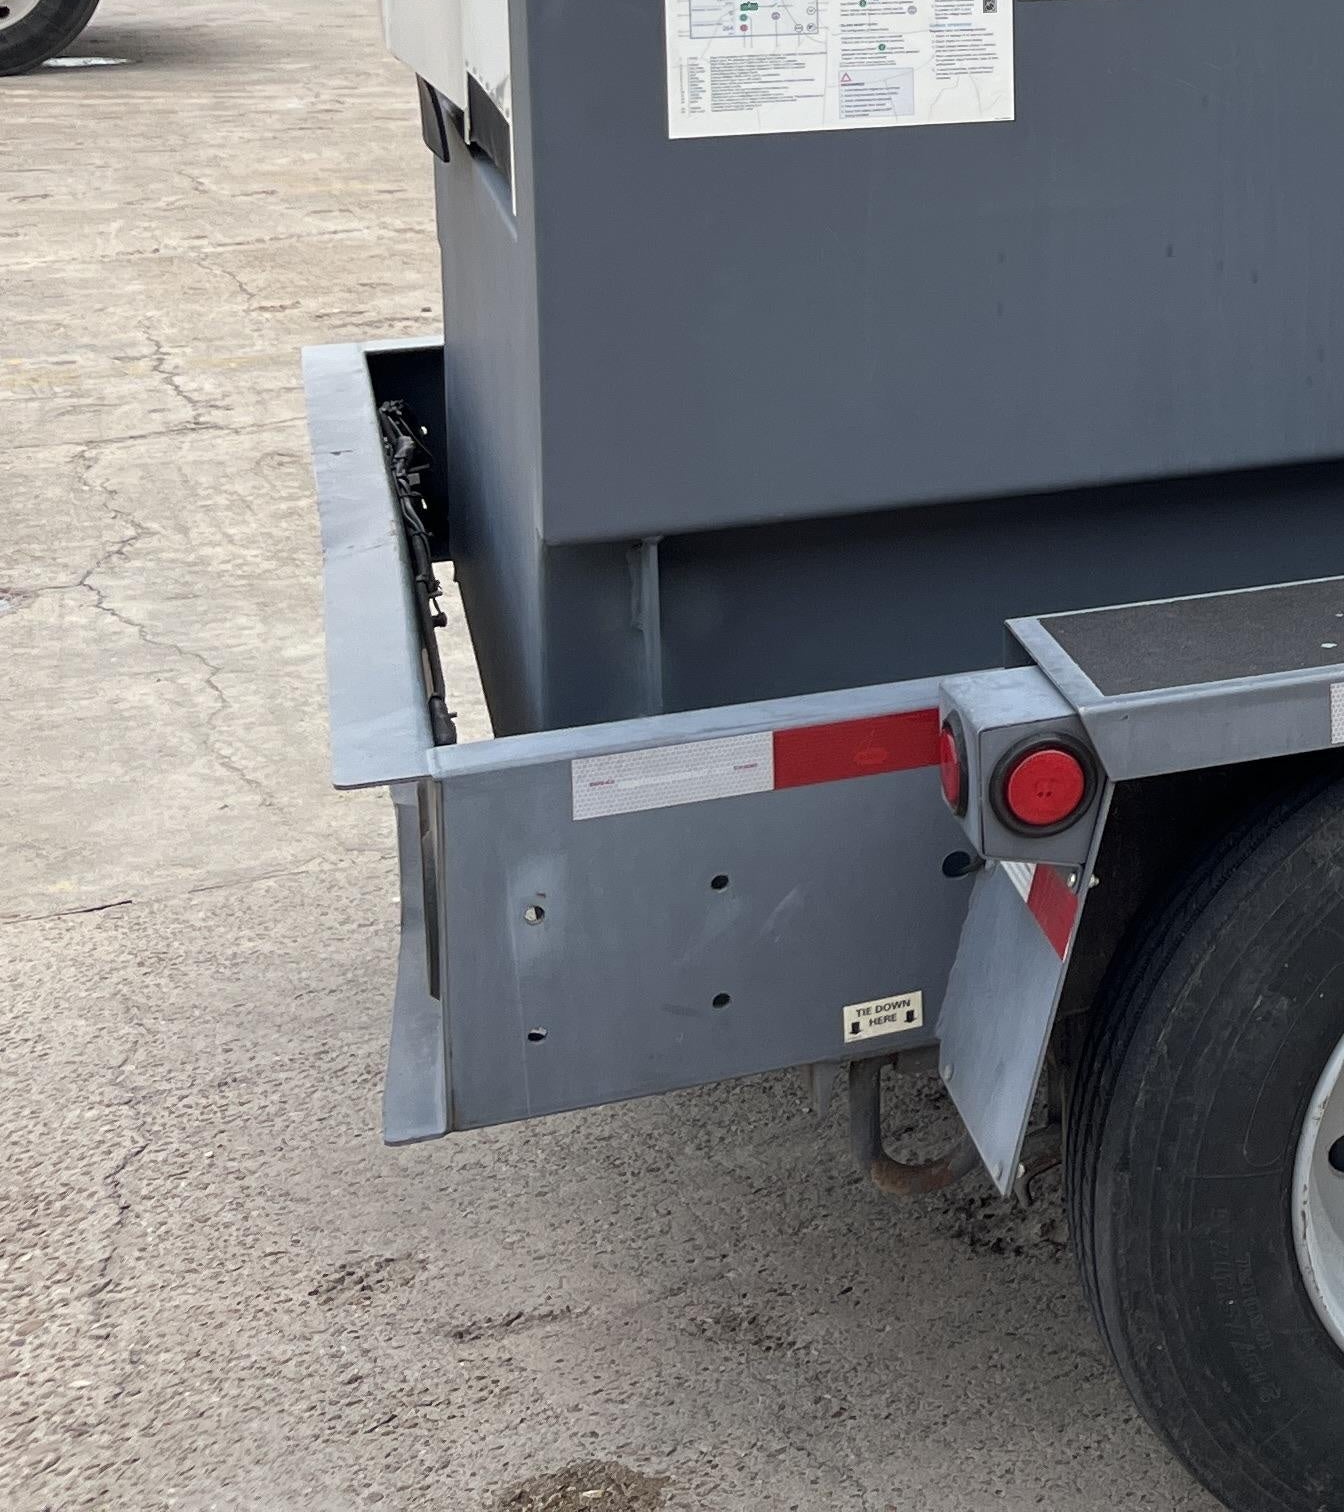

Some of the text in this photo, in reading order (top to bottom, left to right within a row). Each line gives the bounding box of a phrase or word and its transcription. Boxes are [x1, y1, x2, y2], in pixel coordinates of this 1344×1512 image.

[855, 999, 911, 1018] TIE DOWN
[868, 1012, 898, 1027] HERE
